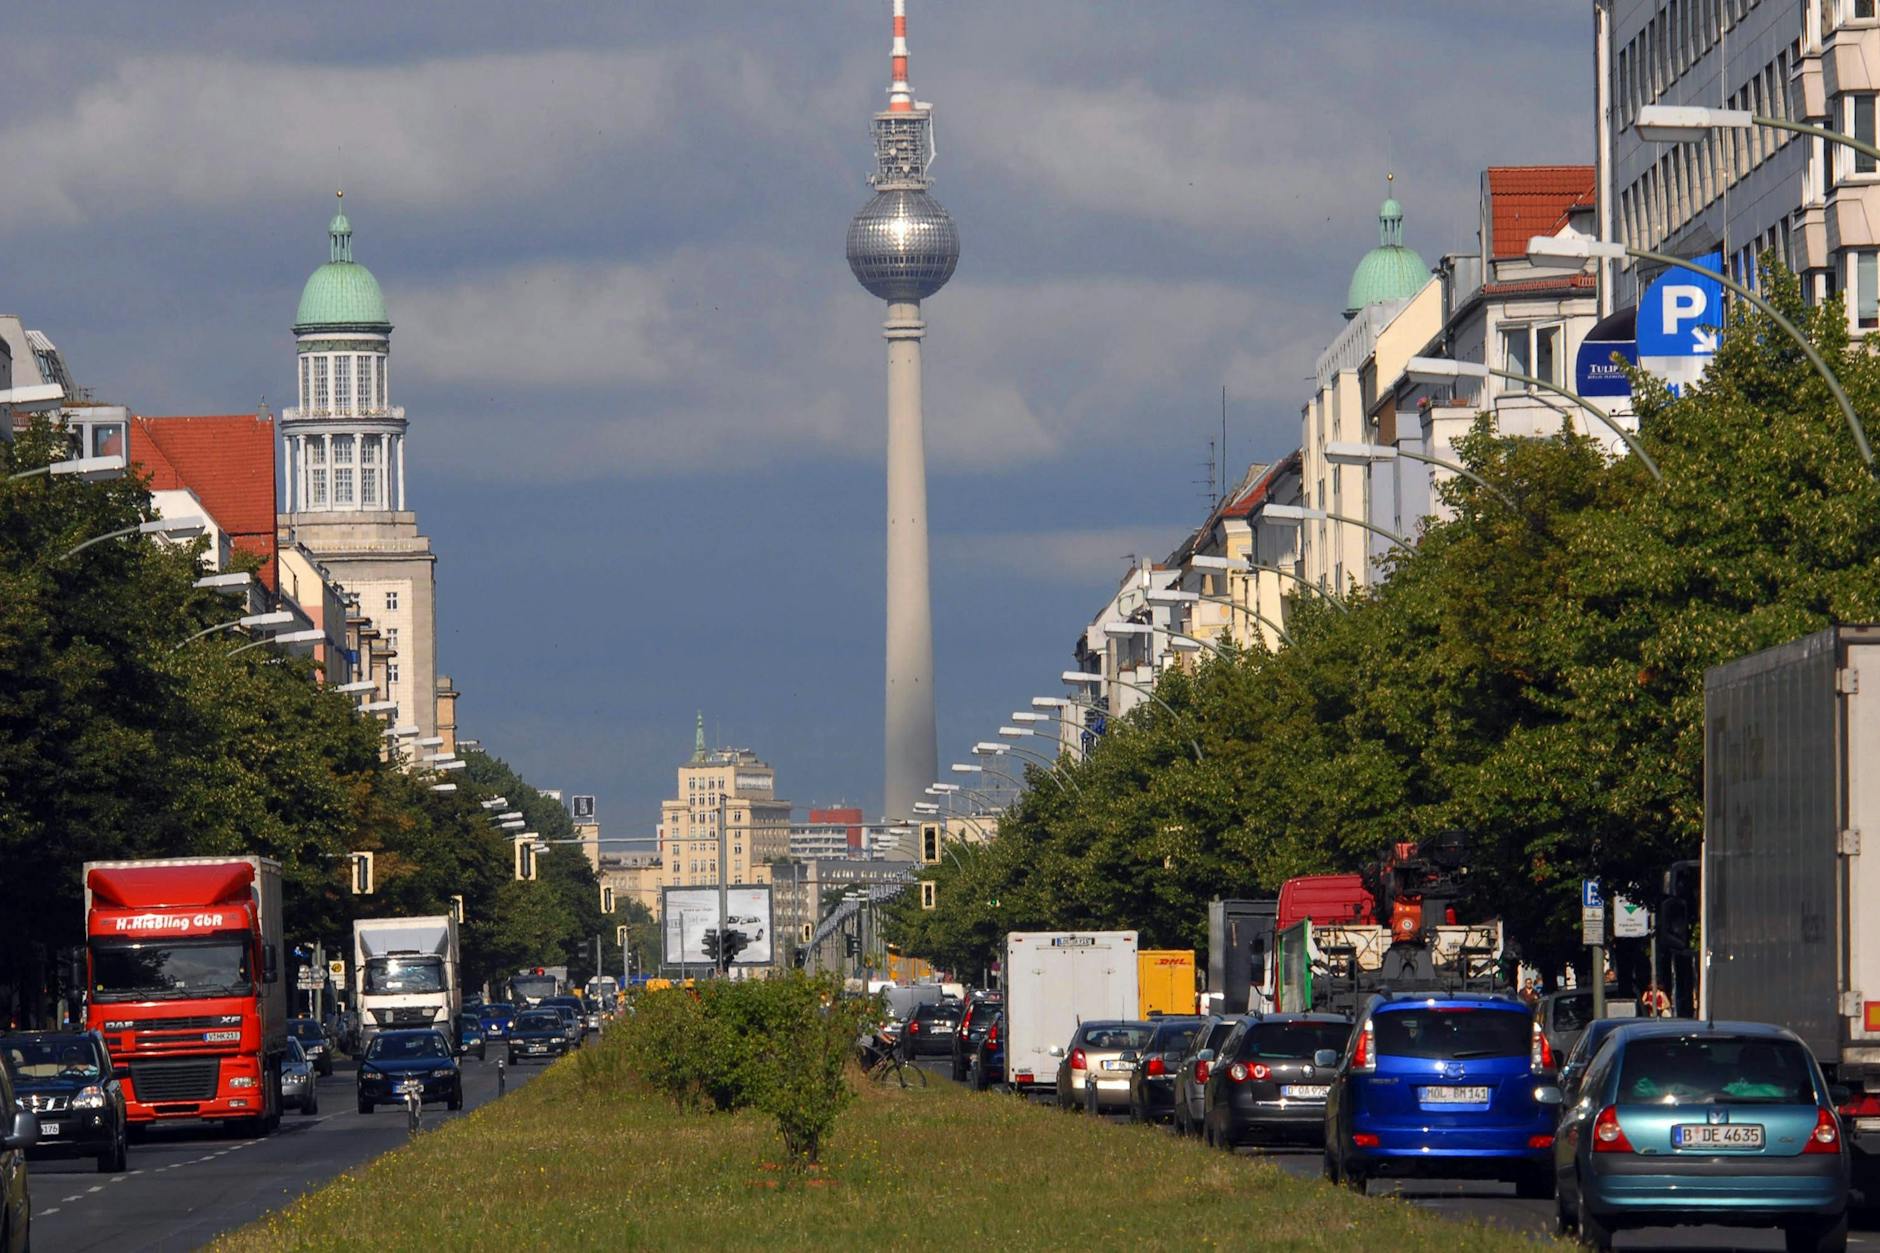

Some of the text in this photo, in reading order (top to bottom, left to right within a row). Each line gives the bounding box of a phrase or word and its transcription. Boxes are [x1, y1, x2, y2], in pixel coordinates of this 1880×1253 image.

[1662, 285, 1707, 335] P
[1589, 364, 1619, 373] TULIP
[193, 914, 223, 927] GbR
[105, 1021, 134, 1029] DAF
[1427, 1088, 1447, 1098] MOL
[1683, 1128, 1760, 1142] B DE 4635
